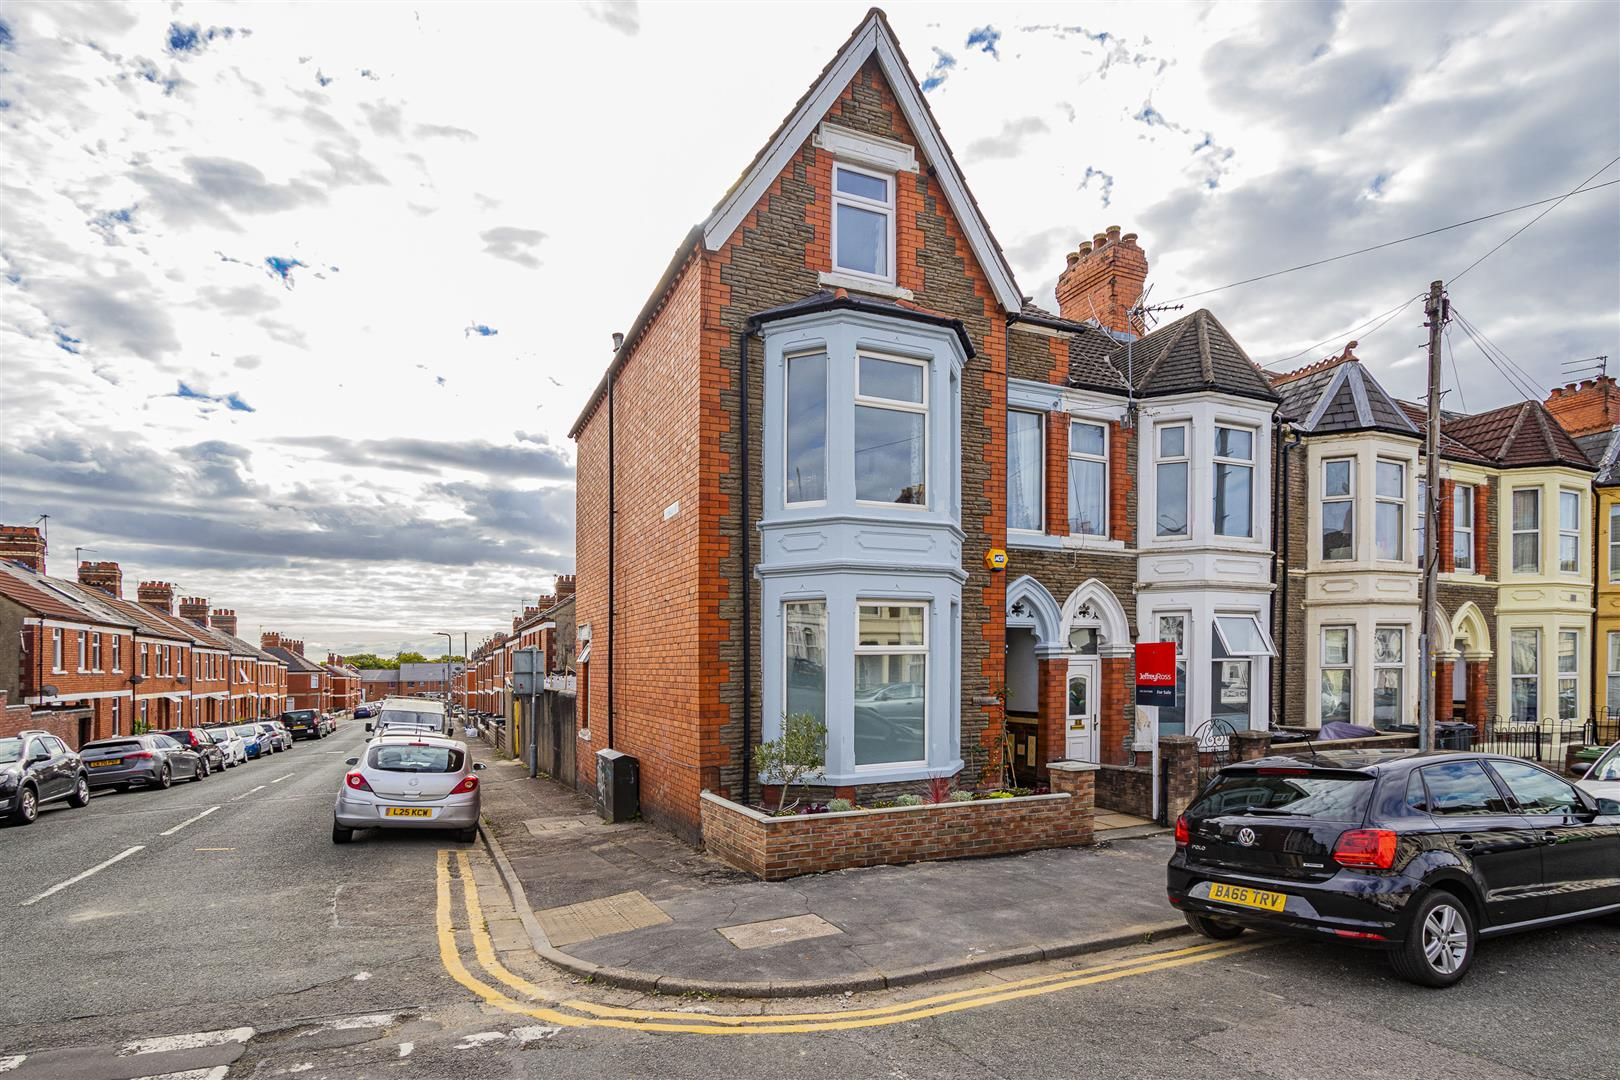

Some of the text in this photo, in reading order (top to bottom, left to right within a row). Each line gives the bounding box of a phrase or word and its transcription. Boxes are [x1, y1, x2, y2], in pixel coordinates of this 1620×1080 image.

[393, 808, 410, 816] L25
[1215, 885, 1279, 907] BA66 TRV
